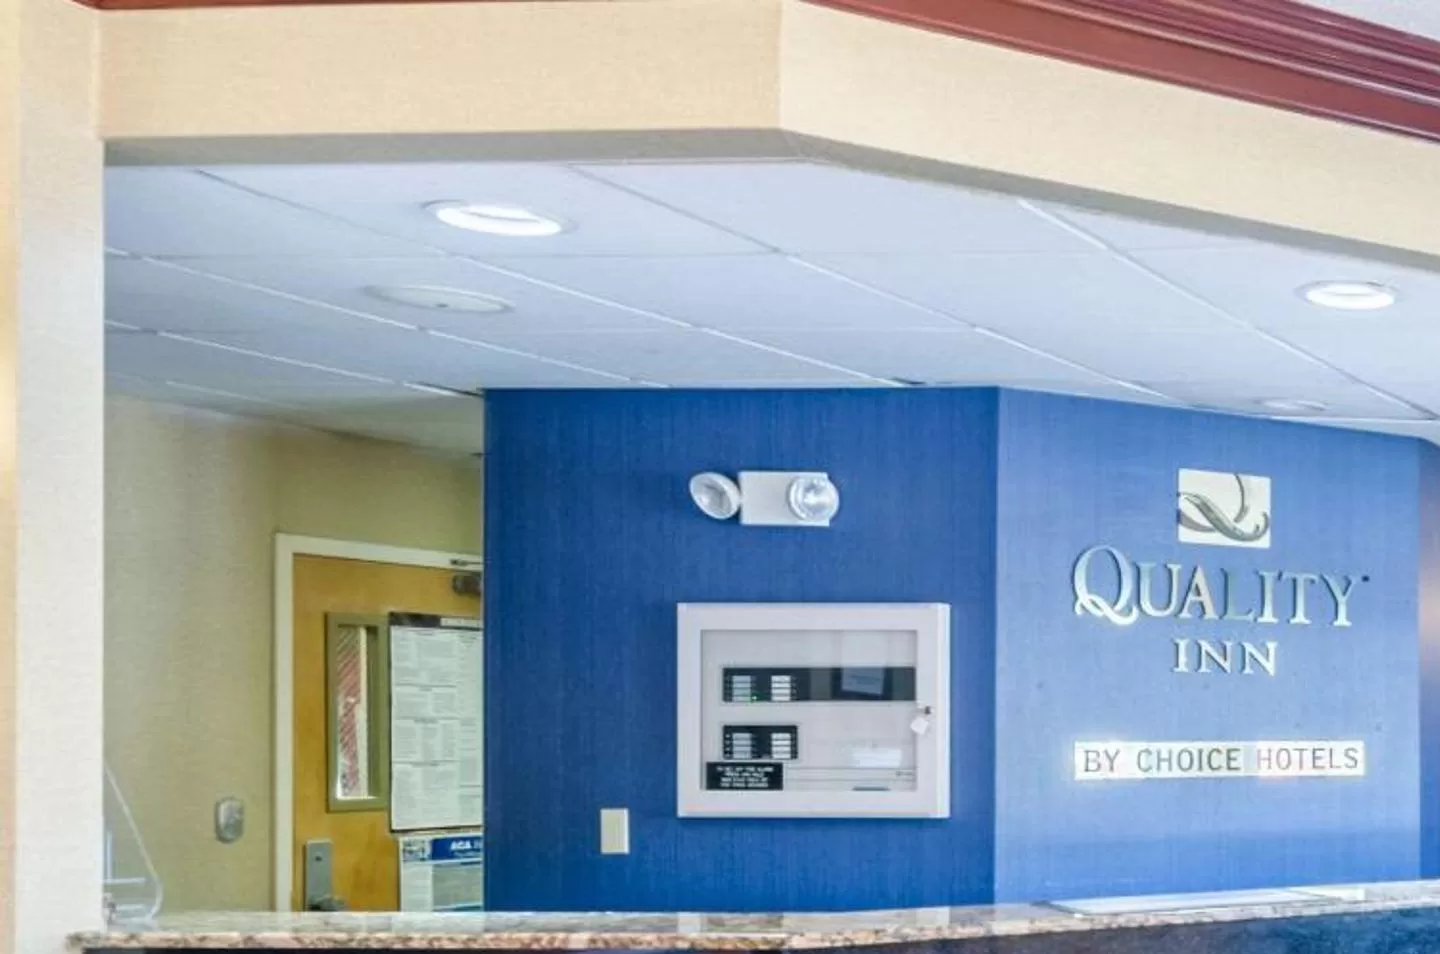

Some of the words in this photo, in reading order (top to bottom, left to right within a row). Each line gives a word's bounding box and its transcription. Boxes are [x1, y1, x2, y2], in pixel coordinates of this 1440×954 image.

[1072, 545, 1358, 627] QUALITY
[1172, 637, 1278, 677] INN
[1083, 749, 1121, 773] BY
[1136, 748, 1241, 772] CHOICE
[1256, 746, 1359, 770] HOTELS
